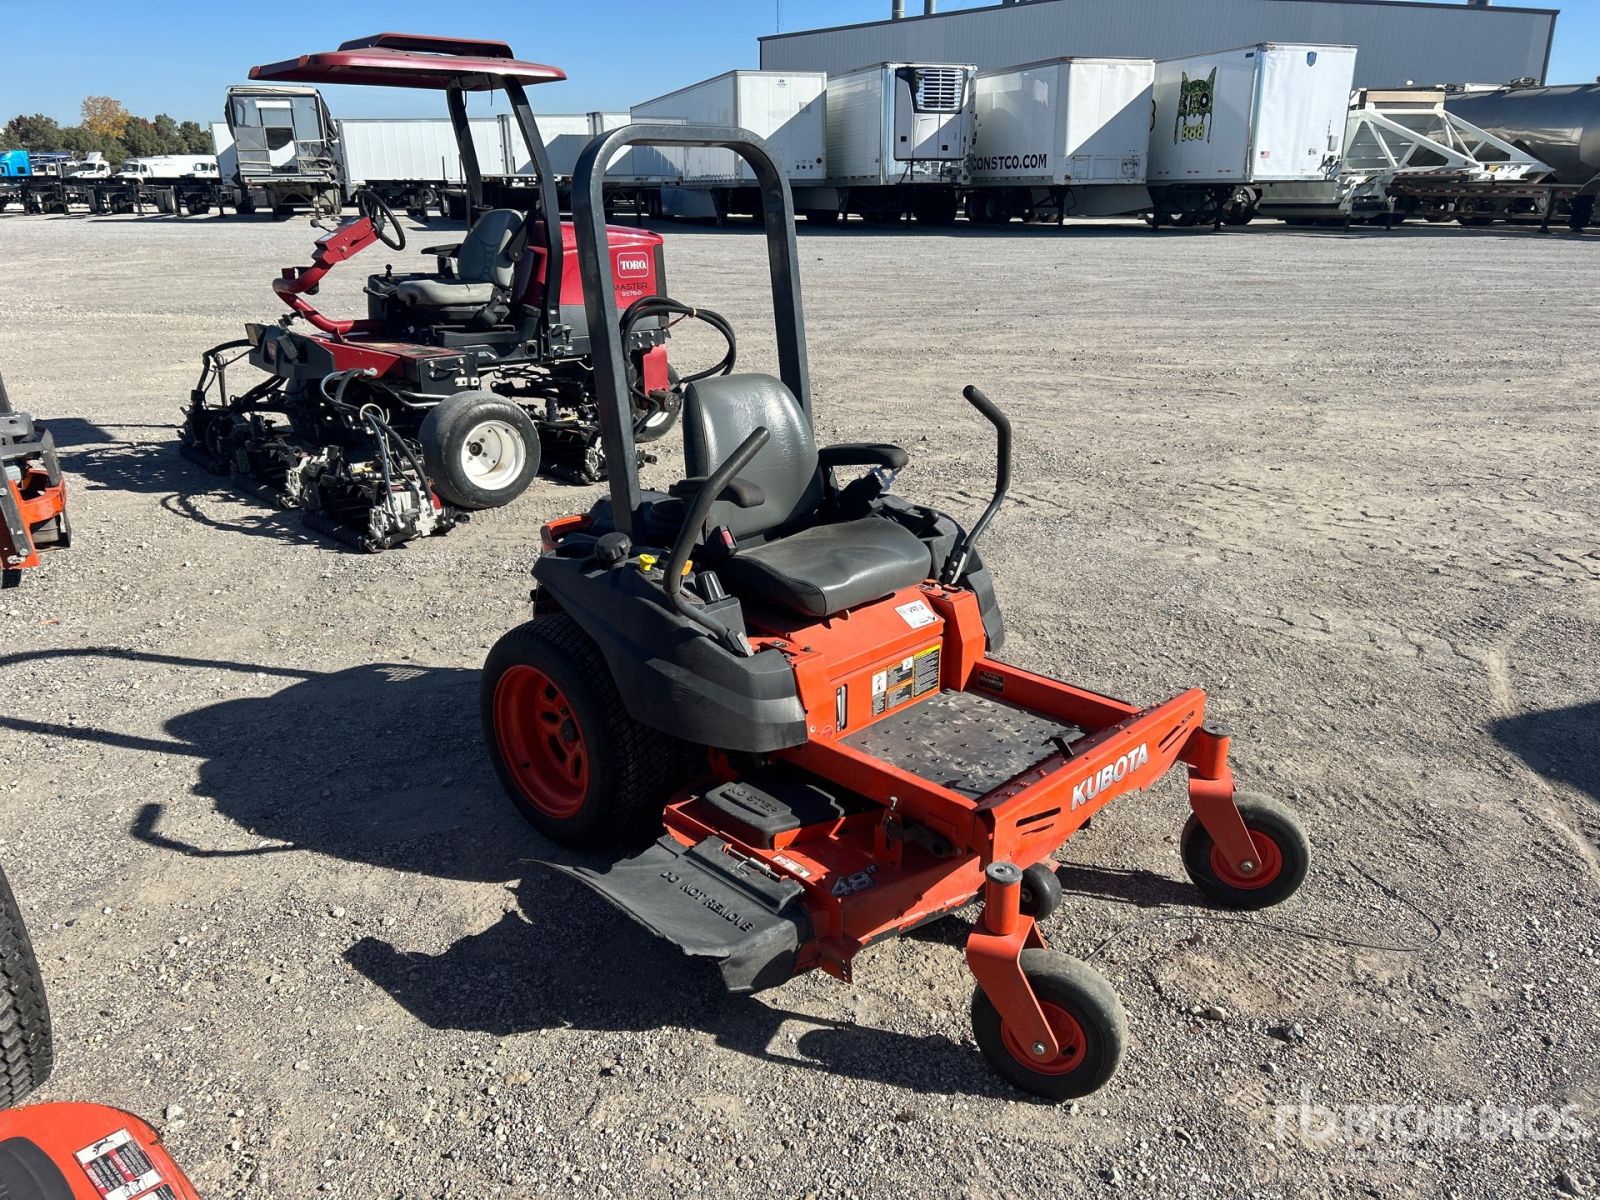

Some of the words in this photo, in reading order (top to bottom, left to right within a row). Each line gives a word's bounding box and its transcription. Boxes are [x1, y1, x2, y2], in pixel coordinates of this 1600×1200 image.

[973, 153, 1048, 171] ONSTCO.COM
[1071, 742, 1148, 812] KUBOTA
[660, 871, 680, 884] DO
[680, 883, 707, 900] NOT
[702, 898, 756, 932] REMOVE
